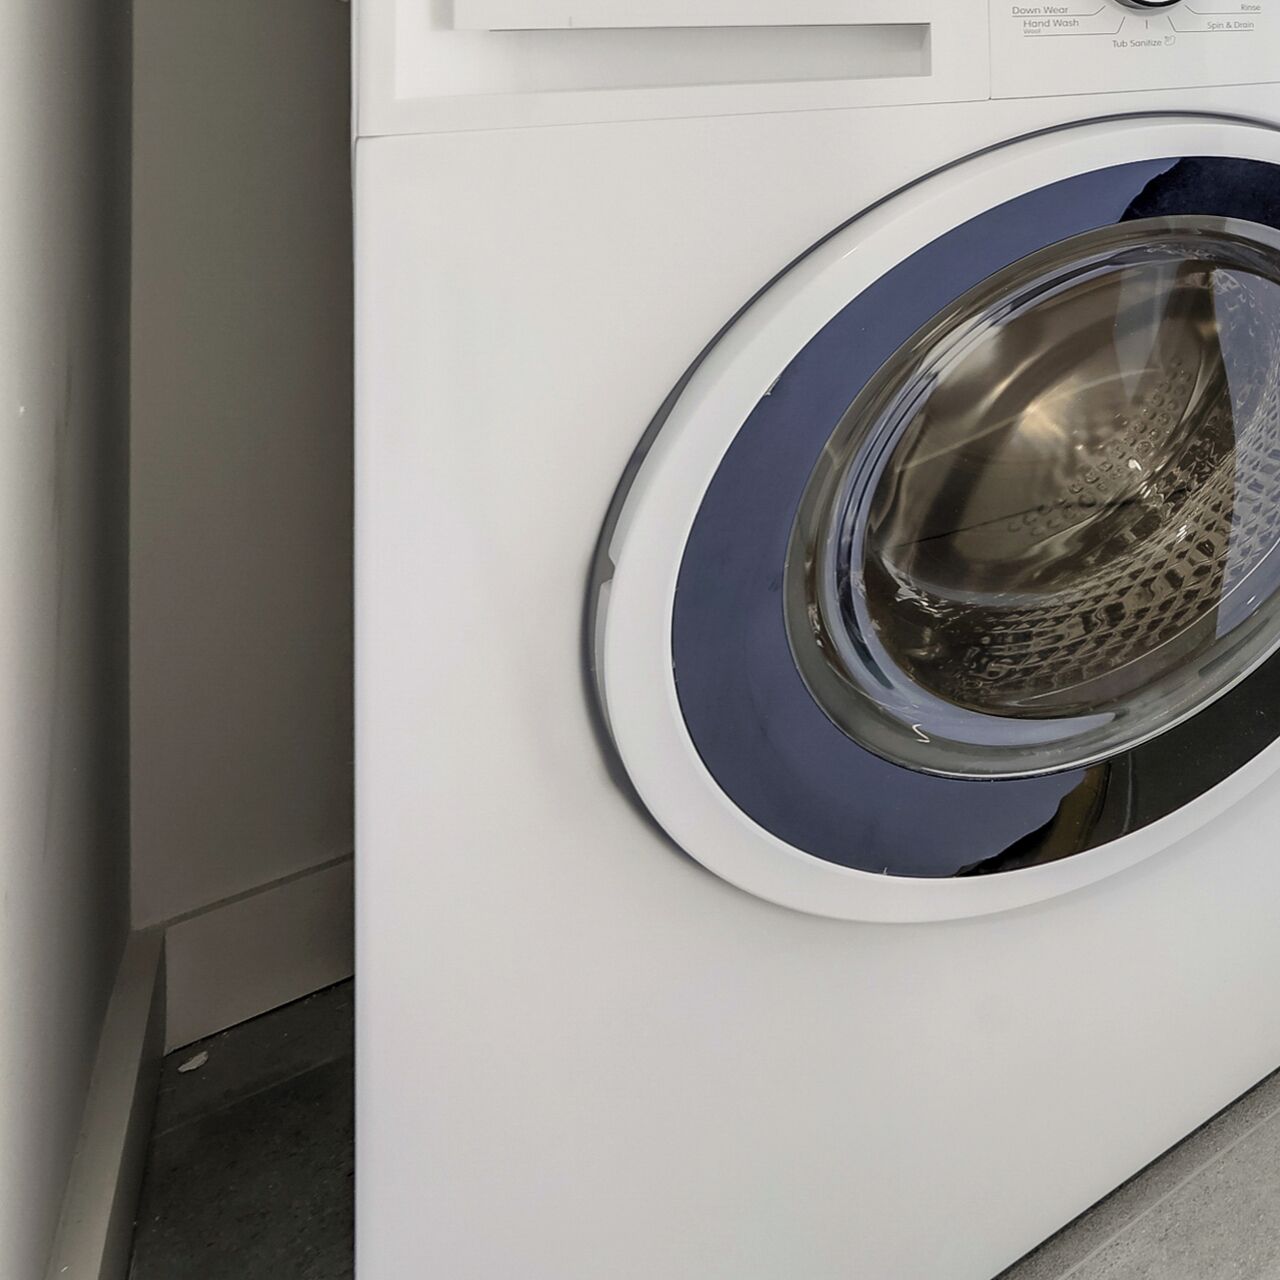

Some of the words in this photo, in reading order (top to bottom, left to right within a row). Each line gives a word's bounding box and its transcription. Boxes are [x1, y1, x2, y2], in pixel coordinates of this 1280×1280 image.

[1012, 6, 1041, 14] Down
[1043, 6, 1068, 14] Wear
[1024, 20, 1050, 28] Hand
[1053, 19, 1079, 27] Wash
[1113, 40, 1128, 48] Tub
[1130, 39, 1162, 47] Sanitize
